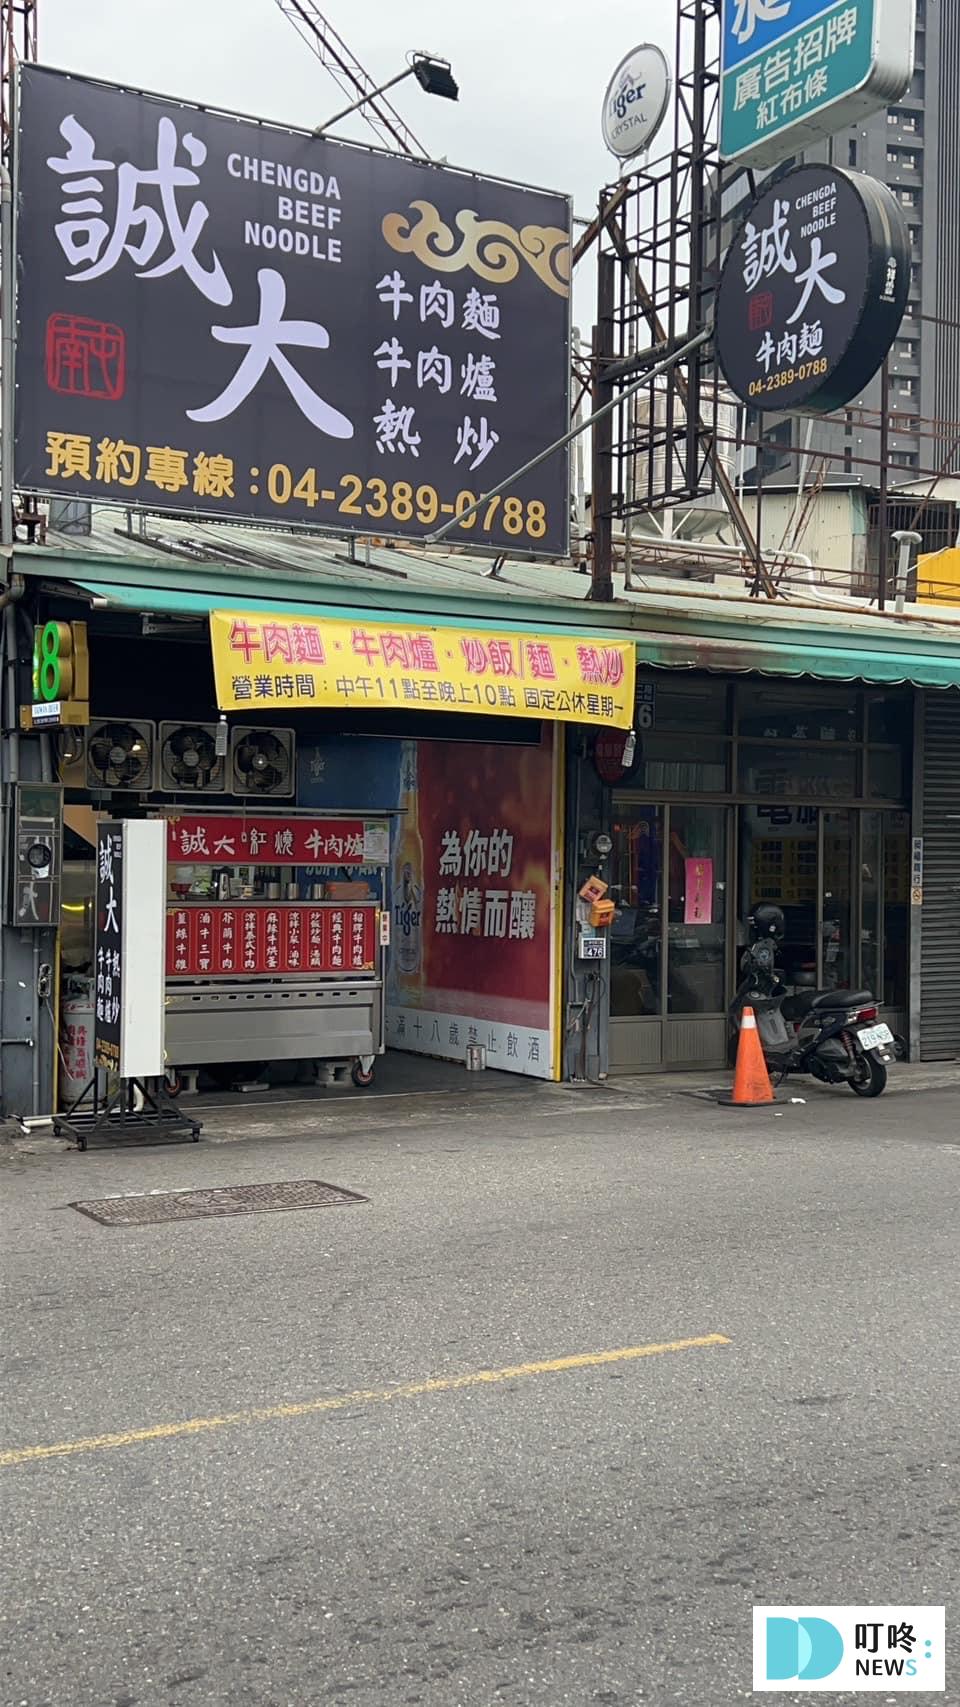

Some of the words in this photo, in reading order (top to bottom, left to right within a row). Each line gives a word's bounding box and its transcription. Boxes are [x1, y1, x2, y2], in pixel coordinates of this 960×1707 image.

[733, 6, 857, 111] 廣告招牌
[755, 65, 828, 129] 紅布條
[226, 152, 342, 201] CHENGDA
[795, 182, 837, 210] CHENGDA
[278, 195, 342, 231] BEEF
[800, 212, 837, 239] NOODLE
[812, 197, 837, 218] BEEF
[244, 220, 342, 264] NOODLE
[375, 270, 502, 340] 牛肉麵
[373, 336, 498, 402] 牛肉爐
[756, 319, 823, 373] 牛肉麵
[748, 357, 828, 396] 04-2389-0788
[523, 687, 624, 718] 固定公休星期一
[439, 828, 514, 877] 為你的
[435, 886, 537, 939] 熱情而釀
